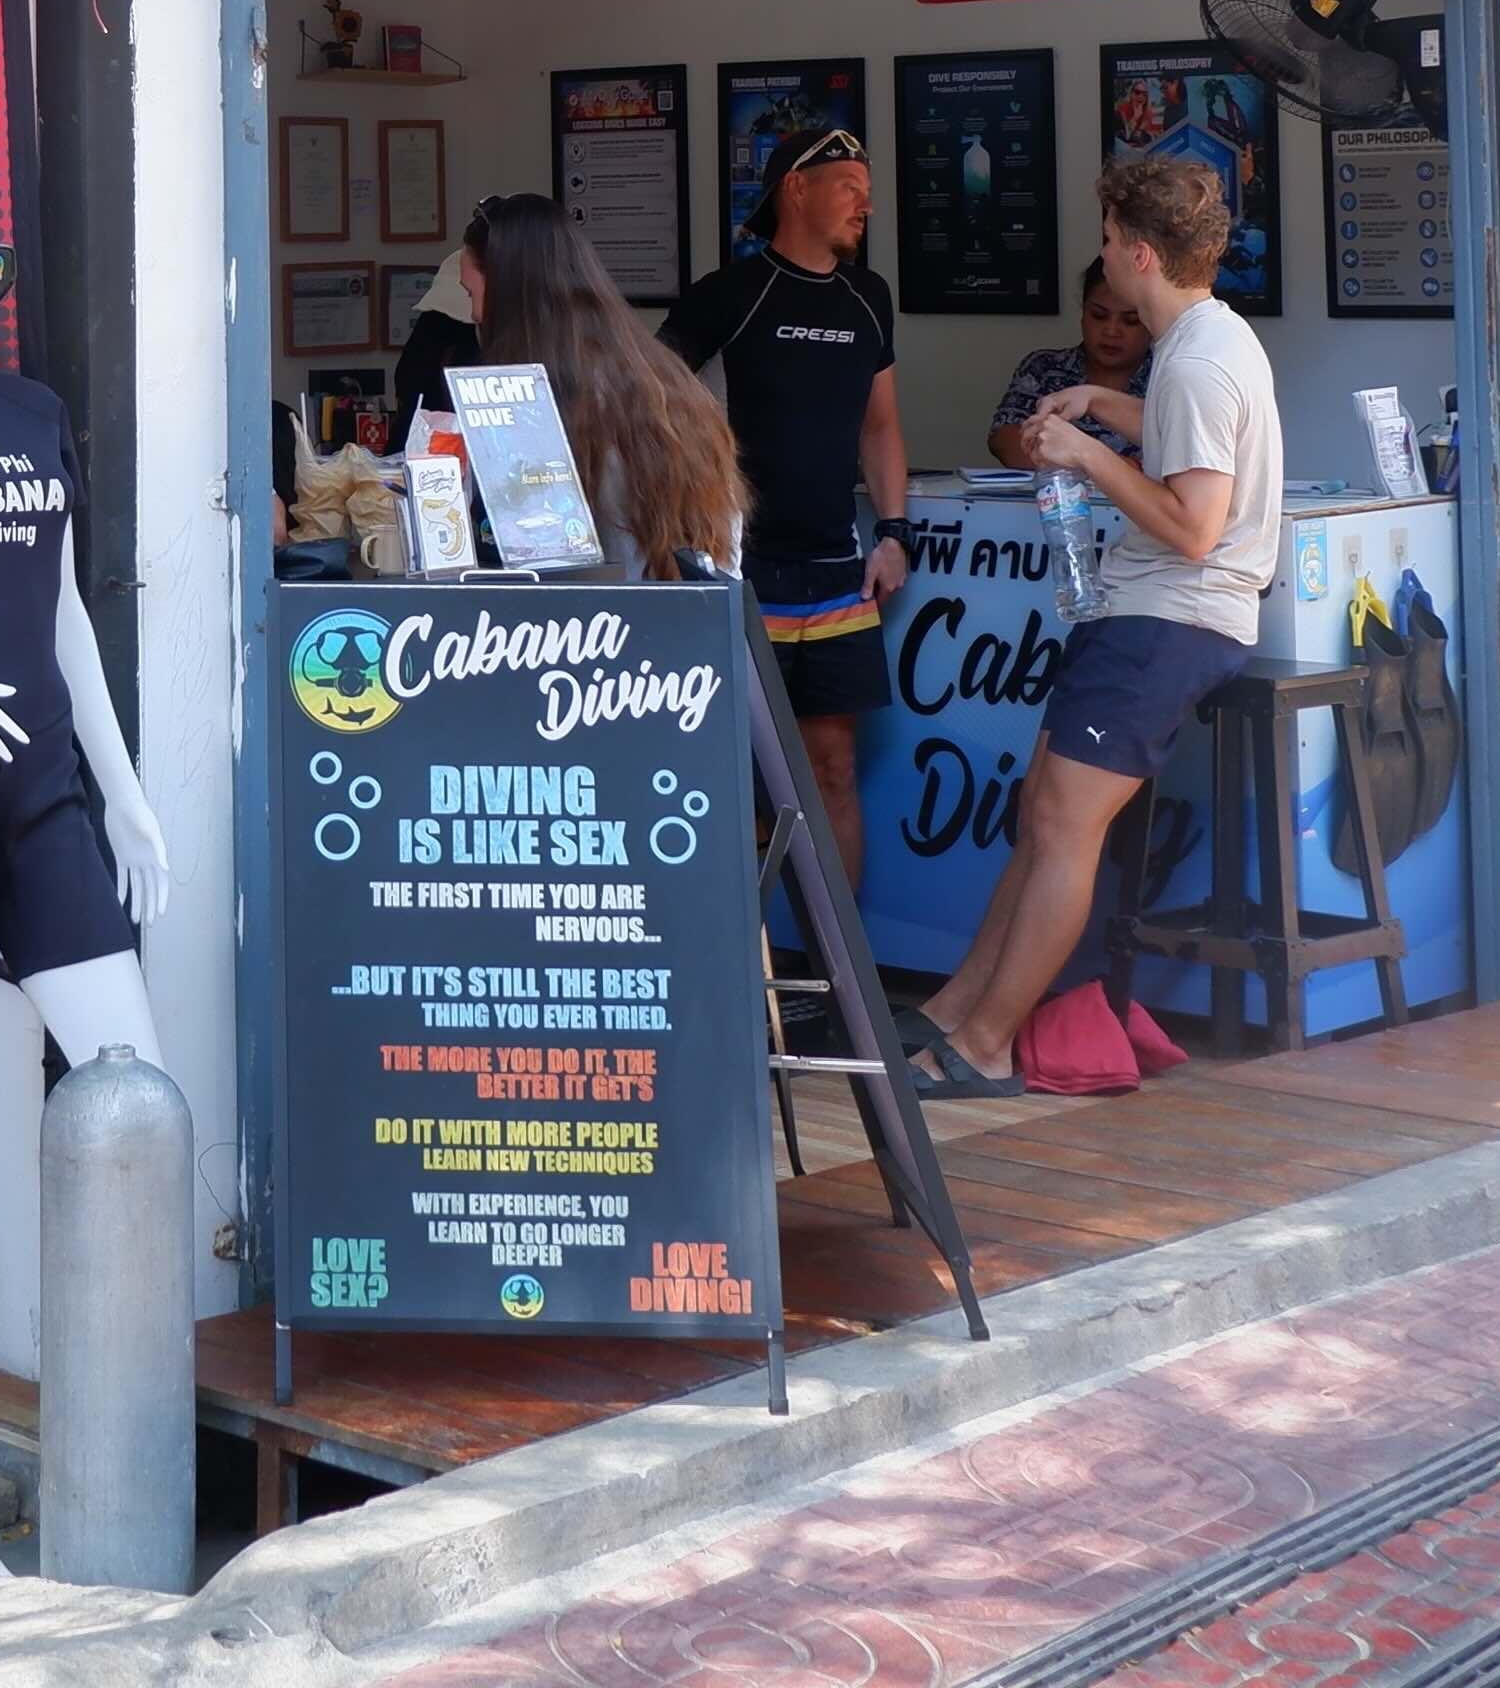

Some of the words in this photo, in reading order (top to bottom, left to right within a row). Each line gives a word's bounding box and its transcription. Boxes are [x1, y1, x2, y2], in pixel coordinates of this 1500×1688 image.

[928, 72, 950, 84] DIVE
[776, 325, 855, 344] CRESSI
[456, 375, 536, 405] NIGHT
[465, 407, 515, 428] DIVE
[0, 454, 34, 475] Phi
[384, 610, 630, 699] Cabana
[897, 597, 1064, 716] Cab
[536, 659, 721, 742] Diving
[429, 765, 596, 815] DIVING
[398, 819, 441, 864] IS
[452, 820, 541, 865] LIKE
[550, 820, 629, 866] SEX
[370, 881, 413, 907] THE
[418, 882, 483, 908] FIRST
[488, 883, 544, 909] TIME
[549, 884, 597, 909] YOU
[601, 885, 646, 910] ARE
[535, 916, 661, 943] NERVOUS...
[331, 965, 406, 995] ...BUT
[412, 966, 462, 997] IT'S
[468, 968, 539, 999] STILL
[545, 968, 597, 999] THE
[602, 969, 672, 1000] BEST
[421, 1002, 489, 1028] THING
[494, 1003, 538, 1029] YOU
[543, 1004, 597, 1029] EVER
[603, 1005, 672, 1030] TRIED.
[380, 1045, 422, 1072] THE
[427, 1046, 492, 1073] MORE
[496, 1047, 542, 1074] YOU
[547, 1048, 580, 1074] DO
[585, 1048, 610, 1077] IT,
[614, 1049, 656, 1075] THE
[477, 1073, 560, 1100] BETTER
[565, 1074, 586, 1100] IT
[592, 1075, 654, 1102] GET'S
[375, 1118, 408, 1144] DO
[413, 1119, 435, 1145] IT
[439, 1119, 501, 1146] WITH
[506, 1120, 571, 1148] MORE
[576, 1122, 658, 1149] PEOPLE
[423, 1149, 481, 1172] LEARN
[486, 1150, 530, 1172] NEW
[534, 1151, 654, 1175] TECHNIQUES
[412, 1192, 464, 1214] WITH
[469, 1193, 586, 1219] EXPERIENCE,
[590, 1195, 629, 1219] YOU
[428, 1221, 487, 1244] LEARN
[491, 1222, 516, 1244] TO
[520, 1223, 548, 1245] GO
[552, 1223, 625, 1247] LONGER
[311, 1237, 386, 1274] LOVE
[492, 1243, 563, 1267] DEEPER
[652, 1242, 728, 1278] LOVE
[310, 1273, 389, 1308] SEX?
[630, 1277, 752, 1314] DIVING!
